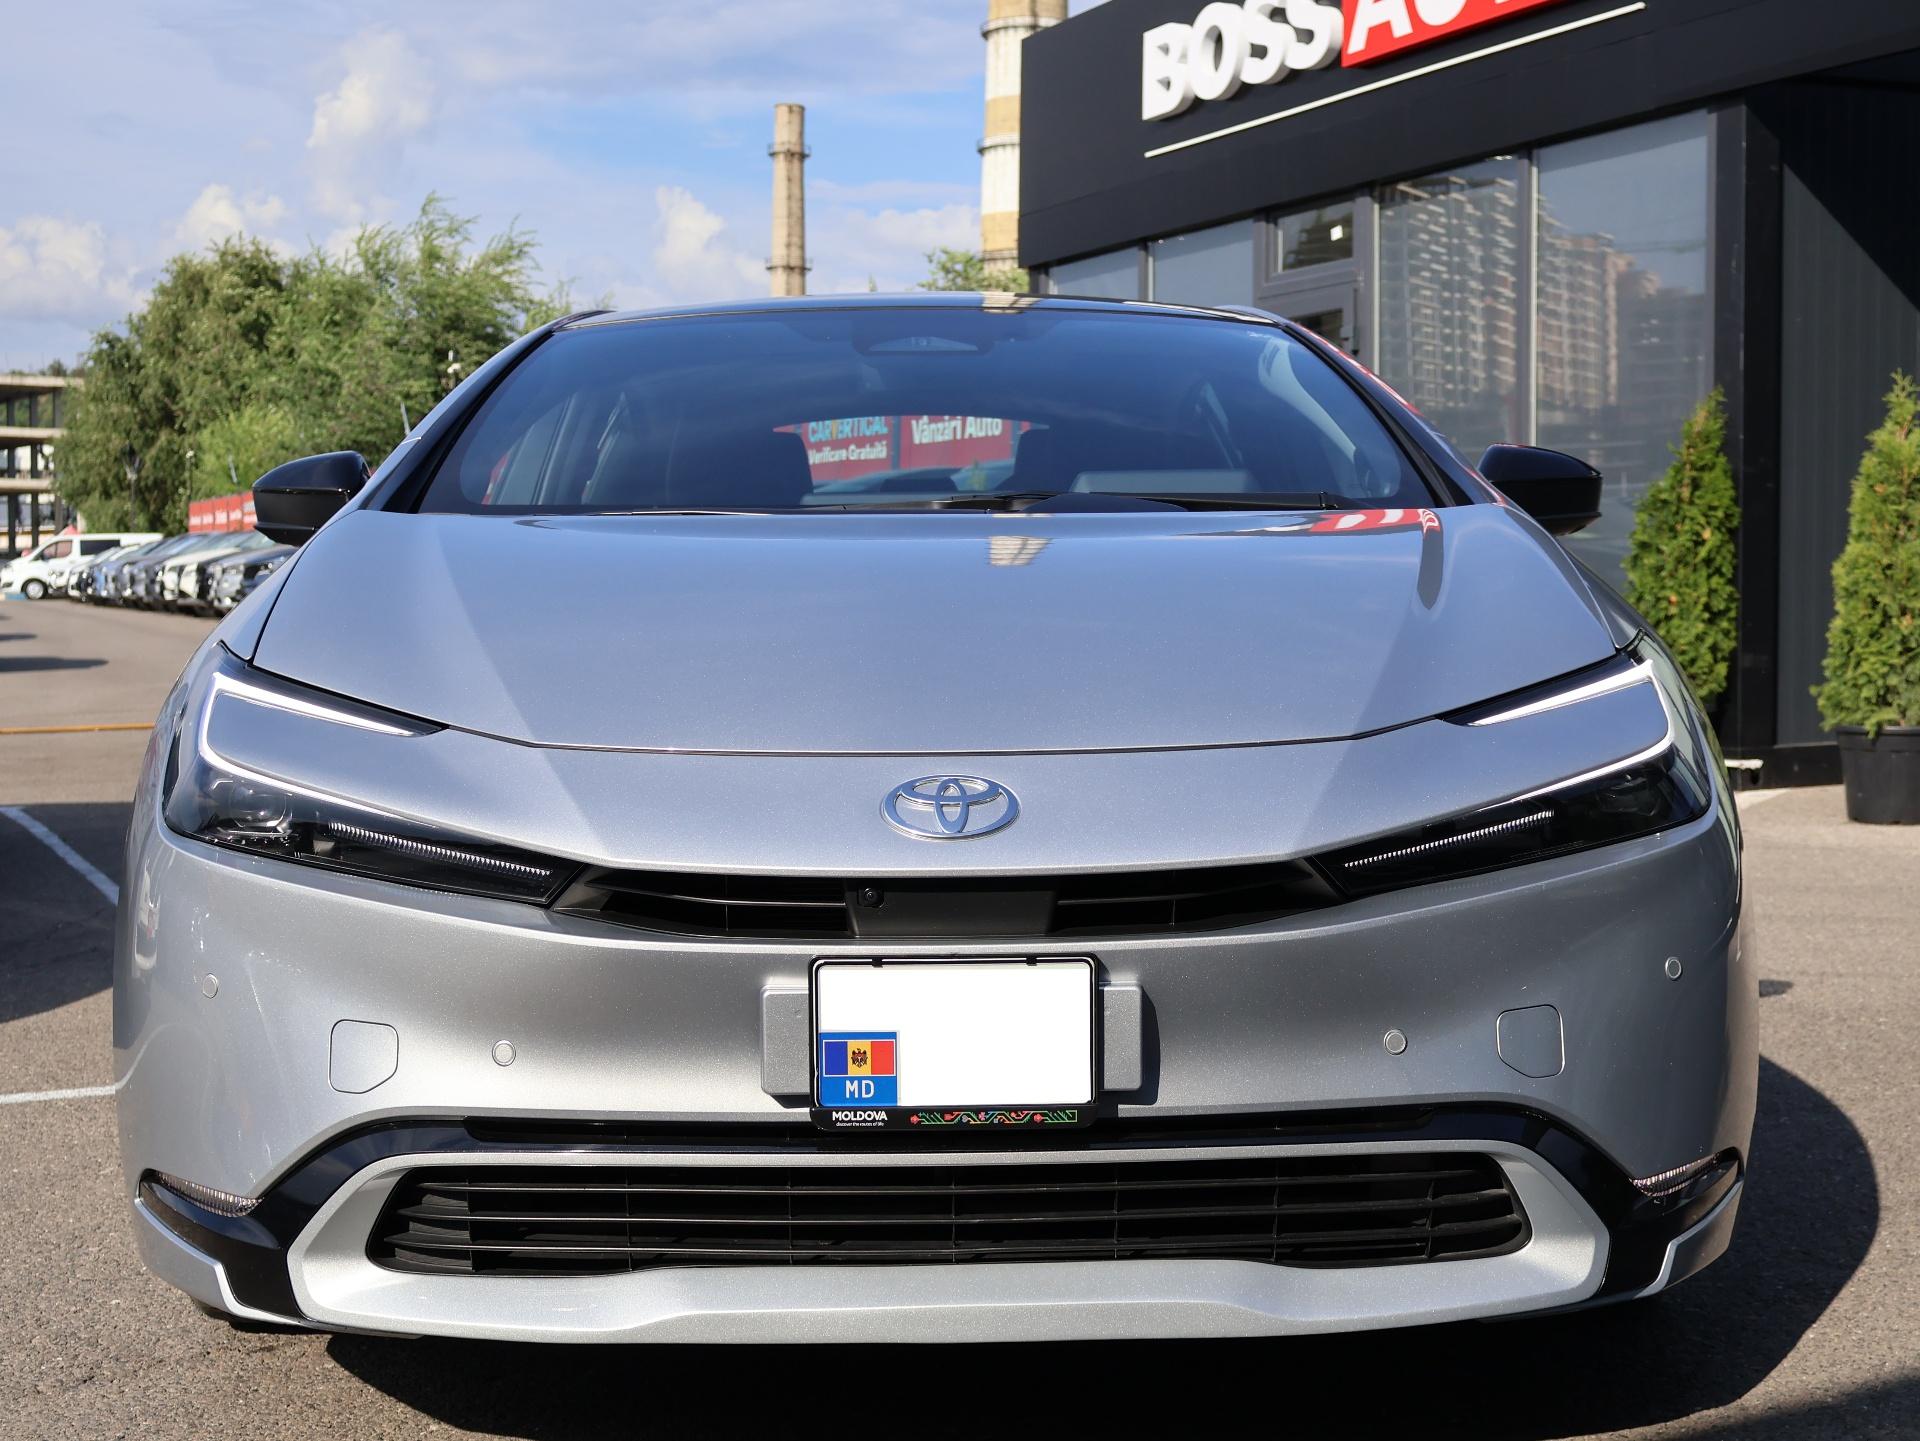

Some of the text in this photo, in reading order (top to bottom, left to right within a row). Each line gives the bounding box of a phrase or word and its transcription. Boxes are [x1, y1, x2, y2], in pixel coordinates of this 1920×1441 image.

[1142, 0, 1345, 121] BOSS
[964, 416, 1003, 439] Auto
[845, 1079, 875, 1099] MD
[832, 1110, 888, 1121] MOLDOVA
